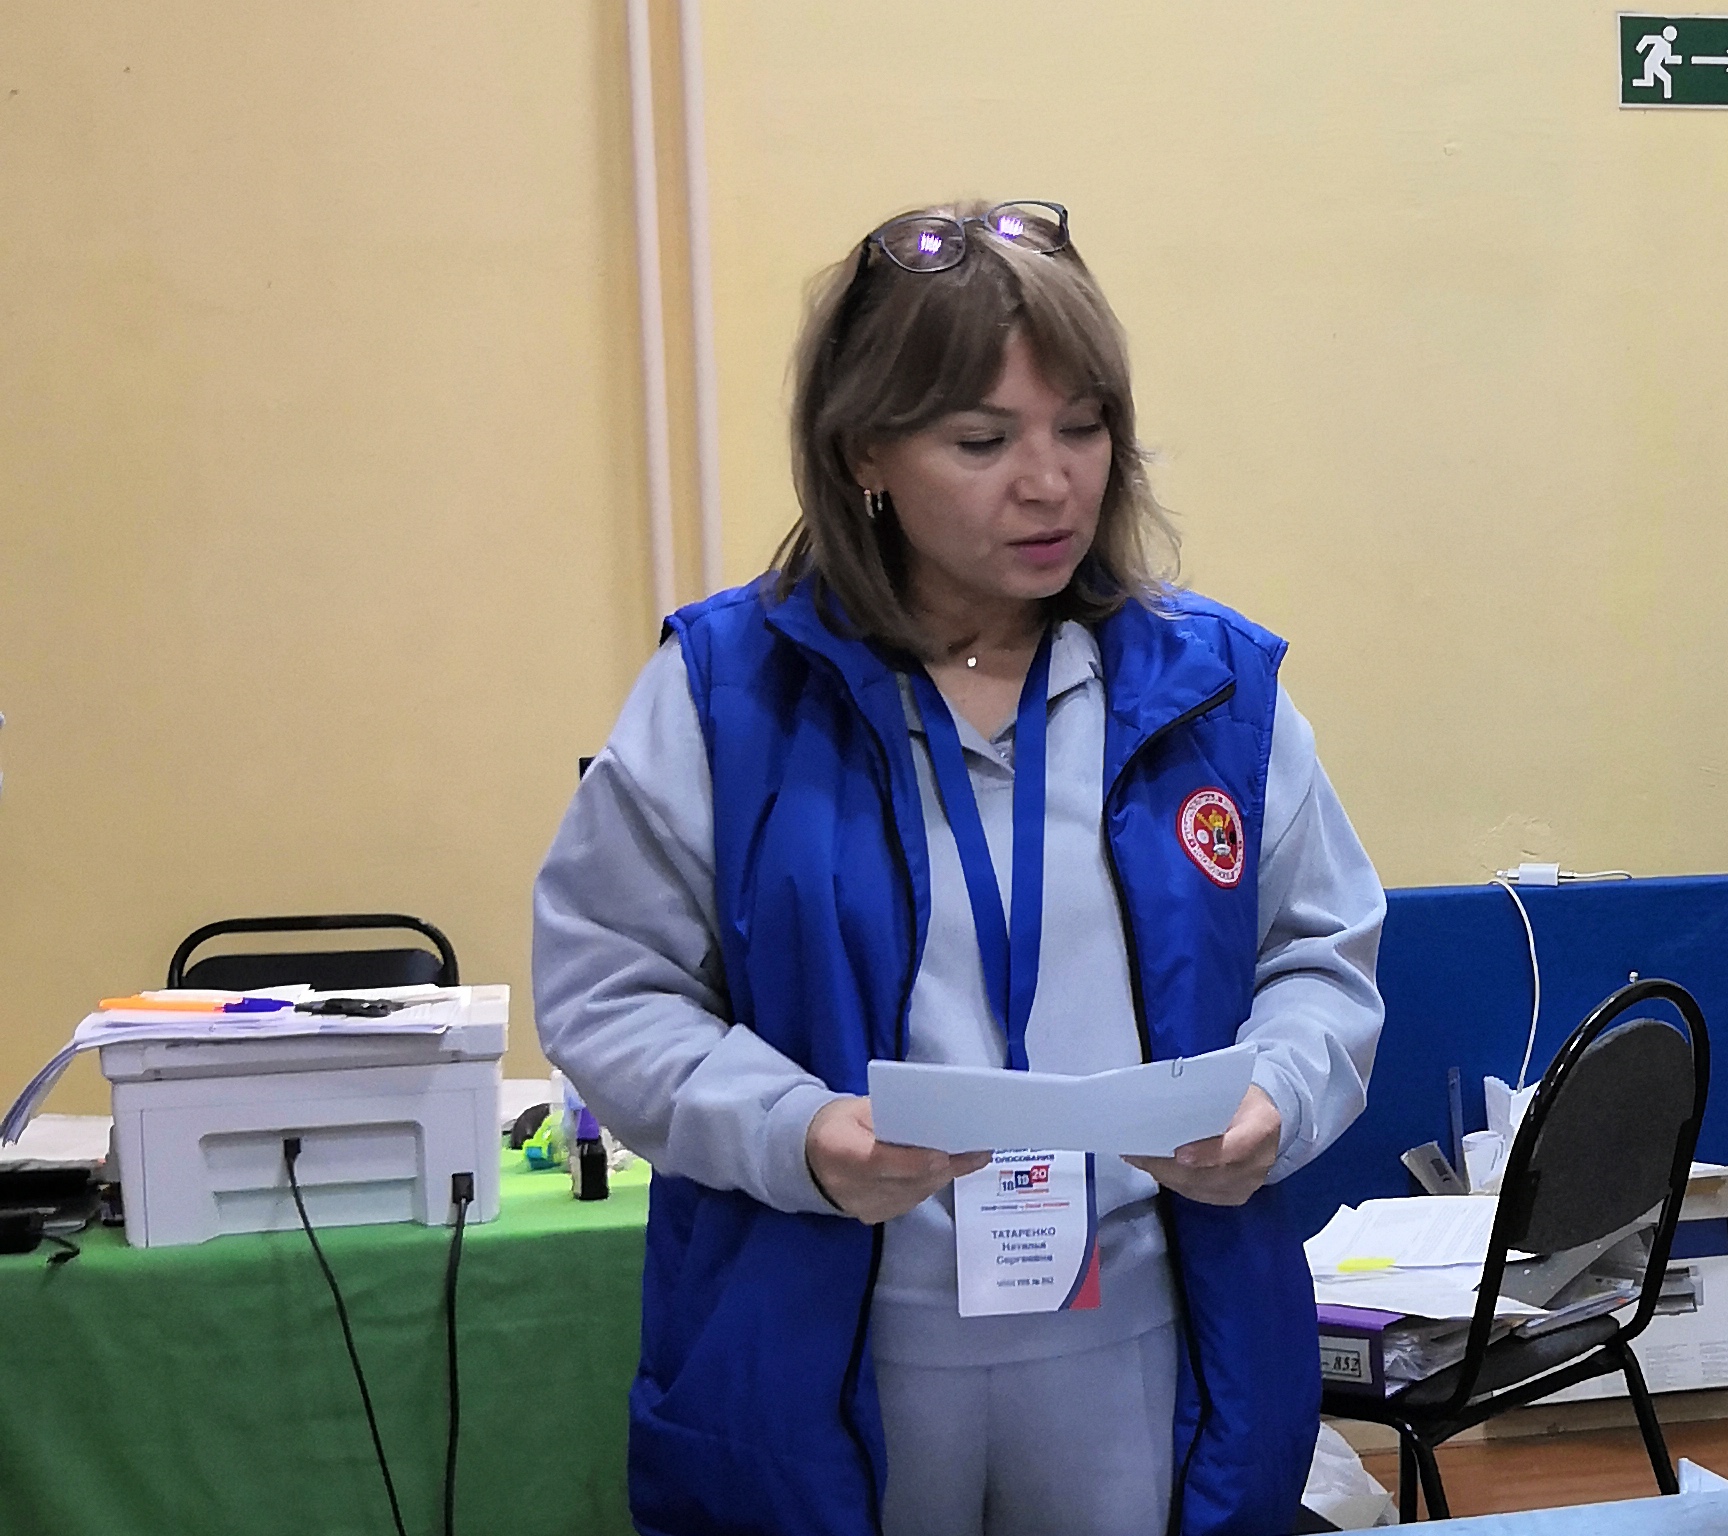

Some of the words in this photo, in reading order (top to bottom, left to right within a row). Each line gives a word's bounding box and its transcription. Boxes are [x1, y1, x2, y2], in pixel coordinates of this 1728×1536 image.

[991, 1154, 1055, 1163] ОЛОСОВАНИЯ
[1031, 1168, 1047, 1180] 20
[991, 1227, 1056, 1239] ТАТАРЕНКО
